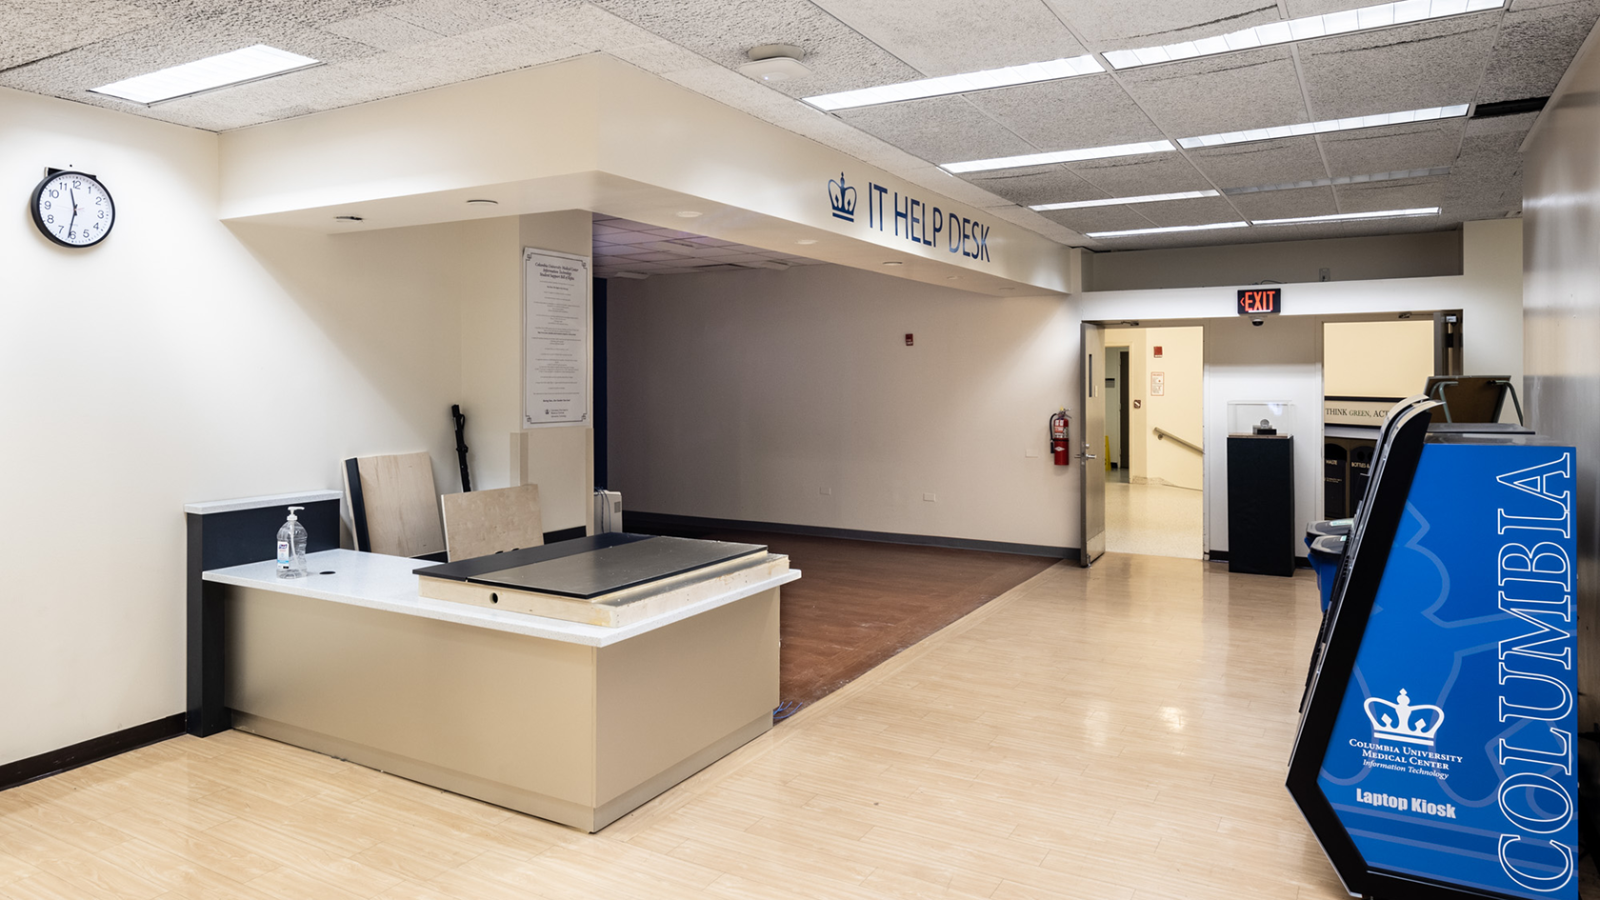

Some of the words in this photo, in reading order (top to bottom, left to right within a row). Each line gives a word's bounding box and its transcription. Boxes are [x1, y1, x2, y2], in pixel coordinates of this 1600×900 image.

[59, 182, 67, 191] 11
[72, 180, 81, 190] 12
[49, 189, 60, 199] 10
[44, 200, 51, 210] 9
[95, 197, 102, 205] 2
[47, 214, 54, 224] 8
[97, 210, 104, 219] 3
[869, 182, 888, 231] IT
[894, 192, 943, 247] HELP
[949, 213, 990, 262] DESK
[58, 225, 64, 234] 7
[83, 229, 90, 238] 5
[70, 231, 76, 239] 6
[1245, 291, 1275, 311] EXIT
[1496, 452, 1574, 892] COLUMBIA
[1349, 738, 1400, 753] COLUMBIA
[1403, 746, 1463, 763] UNIVERSITY
[1362, 749, 1407, 763] MEDICAL
[1409, 756, 1449, 770] CENTER
[1363, 759, 1406, 772] Information
[1408, 766, 1449, 780] Technology
[1356, 788, 1408, 811] Laptop
[1411, 797, 1456, 818] Kiosk
